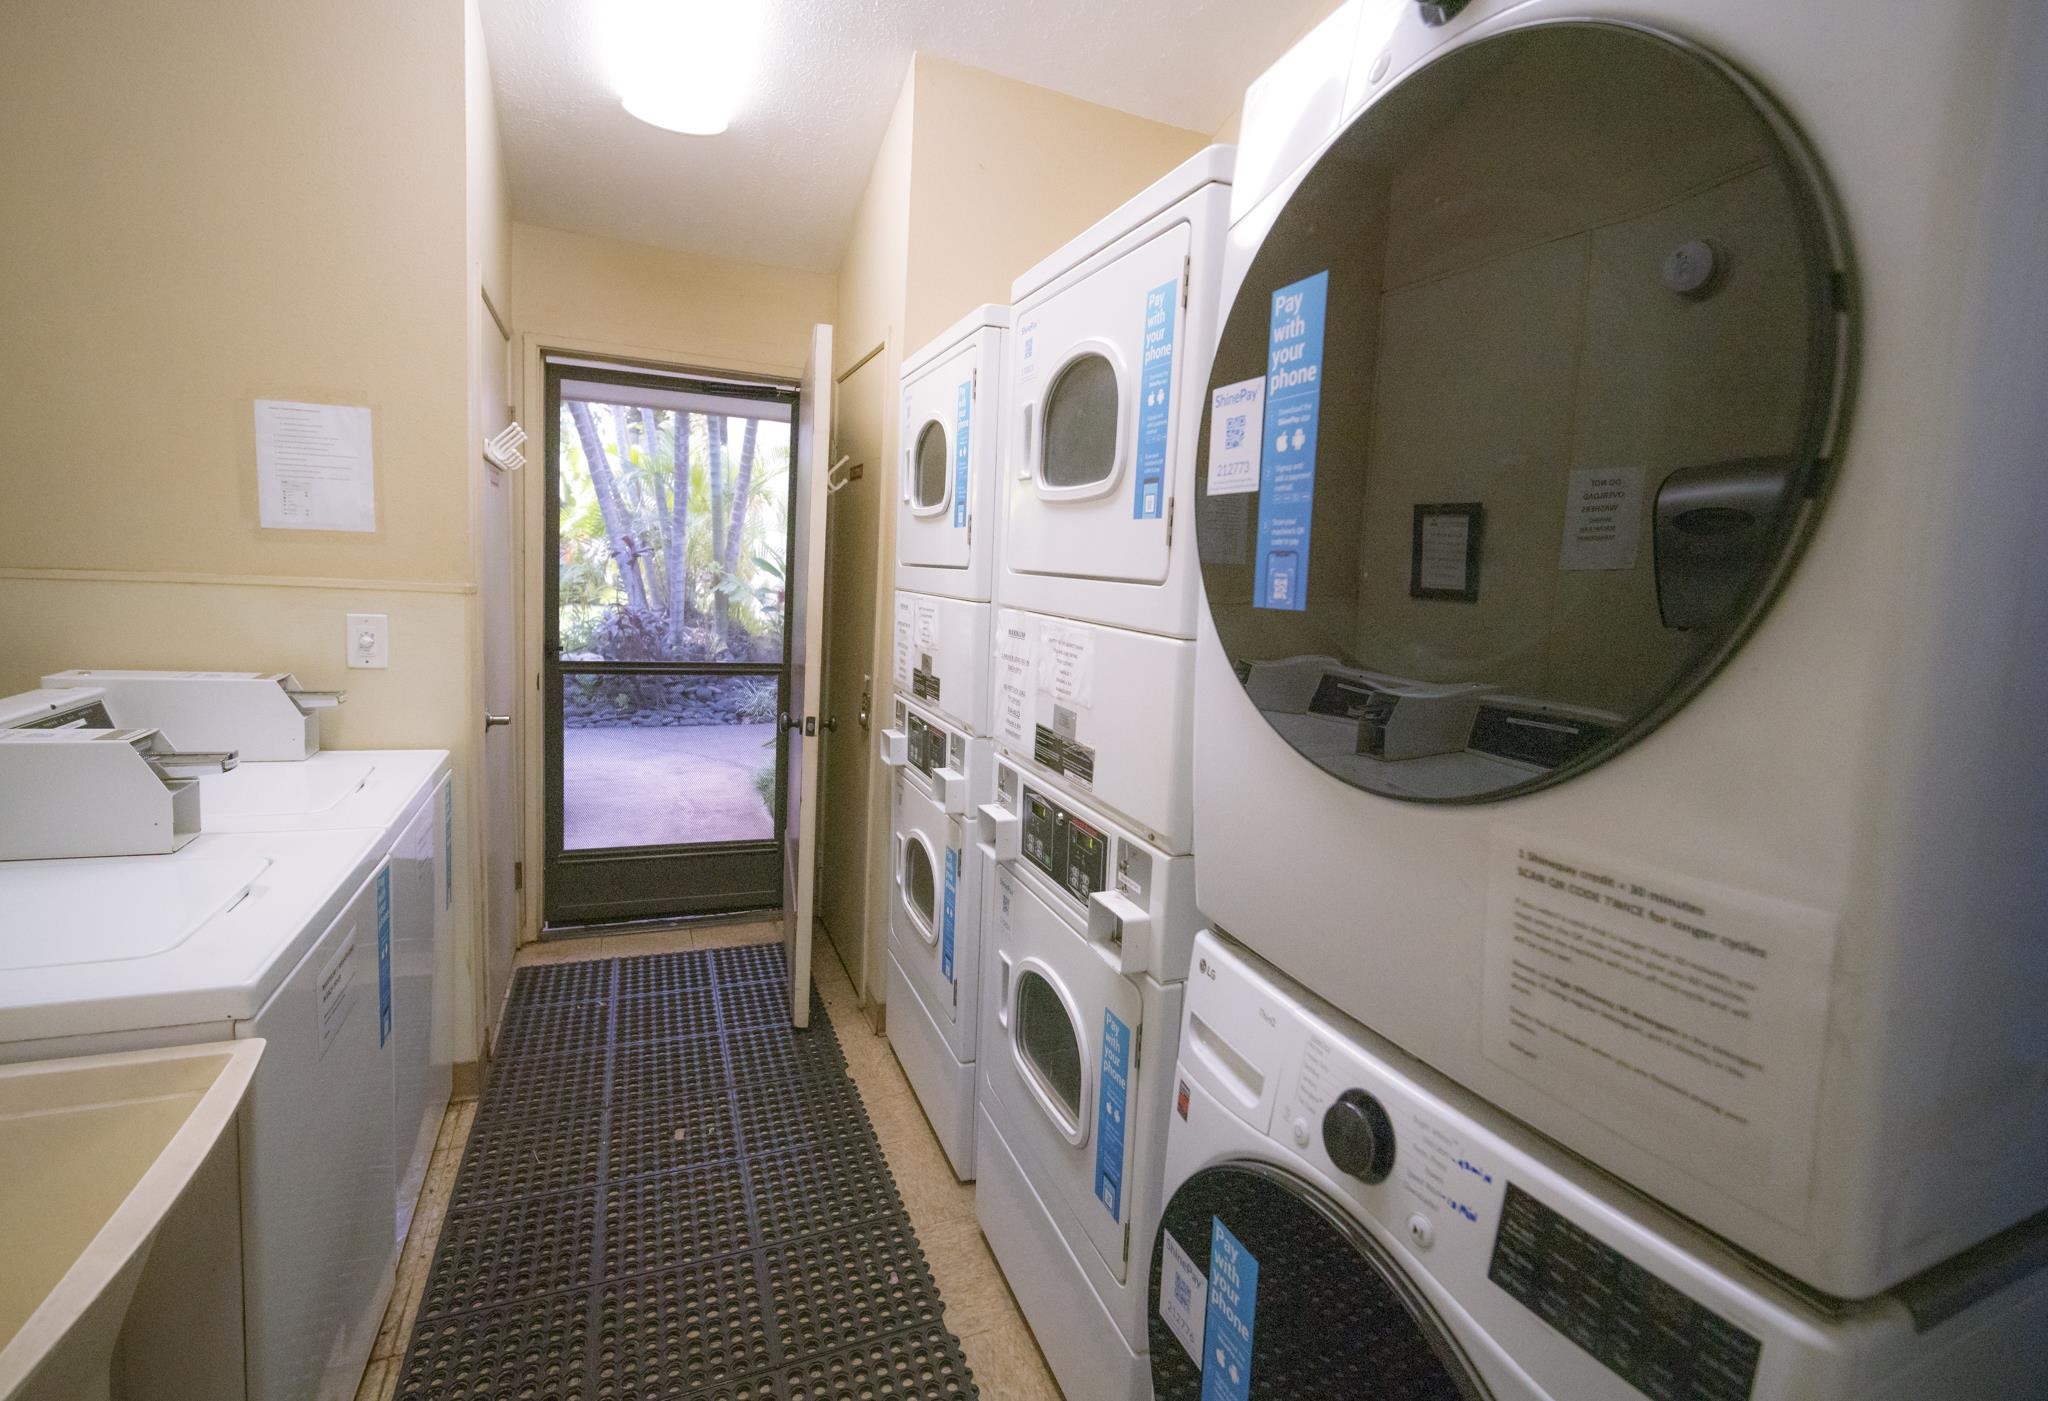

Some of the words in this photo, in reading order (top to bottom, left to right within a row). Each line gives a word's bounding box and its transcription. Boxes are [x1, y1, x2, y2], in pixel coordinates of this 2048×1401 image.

[1148, 292, 1165, 310] Pay
[1275, 292, 1304, 317] Pay
[1147, 309, 1166, 328] with
[1274, 314, 1306, 343] with
[1145, 327, 1166, 349] your
[1144, 343, 1172, 366] phone
[1272, 342, 1306, 372] your
[1270, 364, 1318, 396] phone
[1215, 388, 1258, 408] ShinePay
[1217, 460, 1250, 477] 212773
[1518, 866, 1546, 884] SCAN
[1568, 883, 1600, 903] CODE
[1648, 909, 1669, 925] for
[1670, 917, 1718, 941] longer
[1719, 935, 1767, 959] cycles
[1648, 891, 1706, 918] minutes
[1206, 965, 1217, 981] LG
[1103, 1059, 1126, 1089] phone
[1215, 1225, 1239, 1263] Pay
[1214, 1249, 1240, 1288] with
[1213, 1268, 1240, 1306] your
[1211, 1288, 1249, 1342] phone
